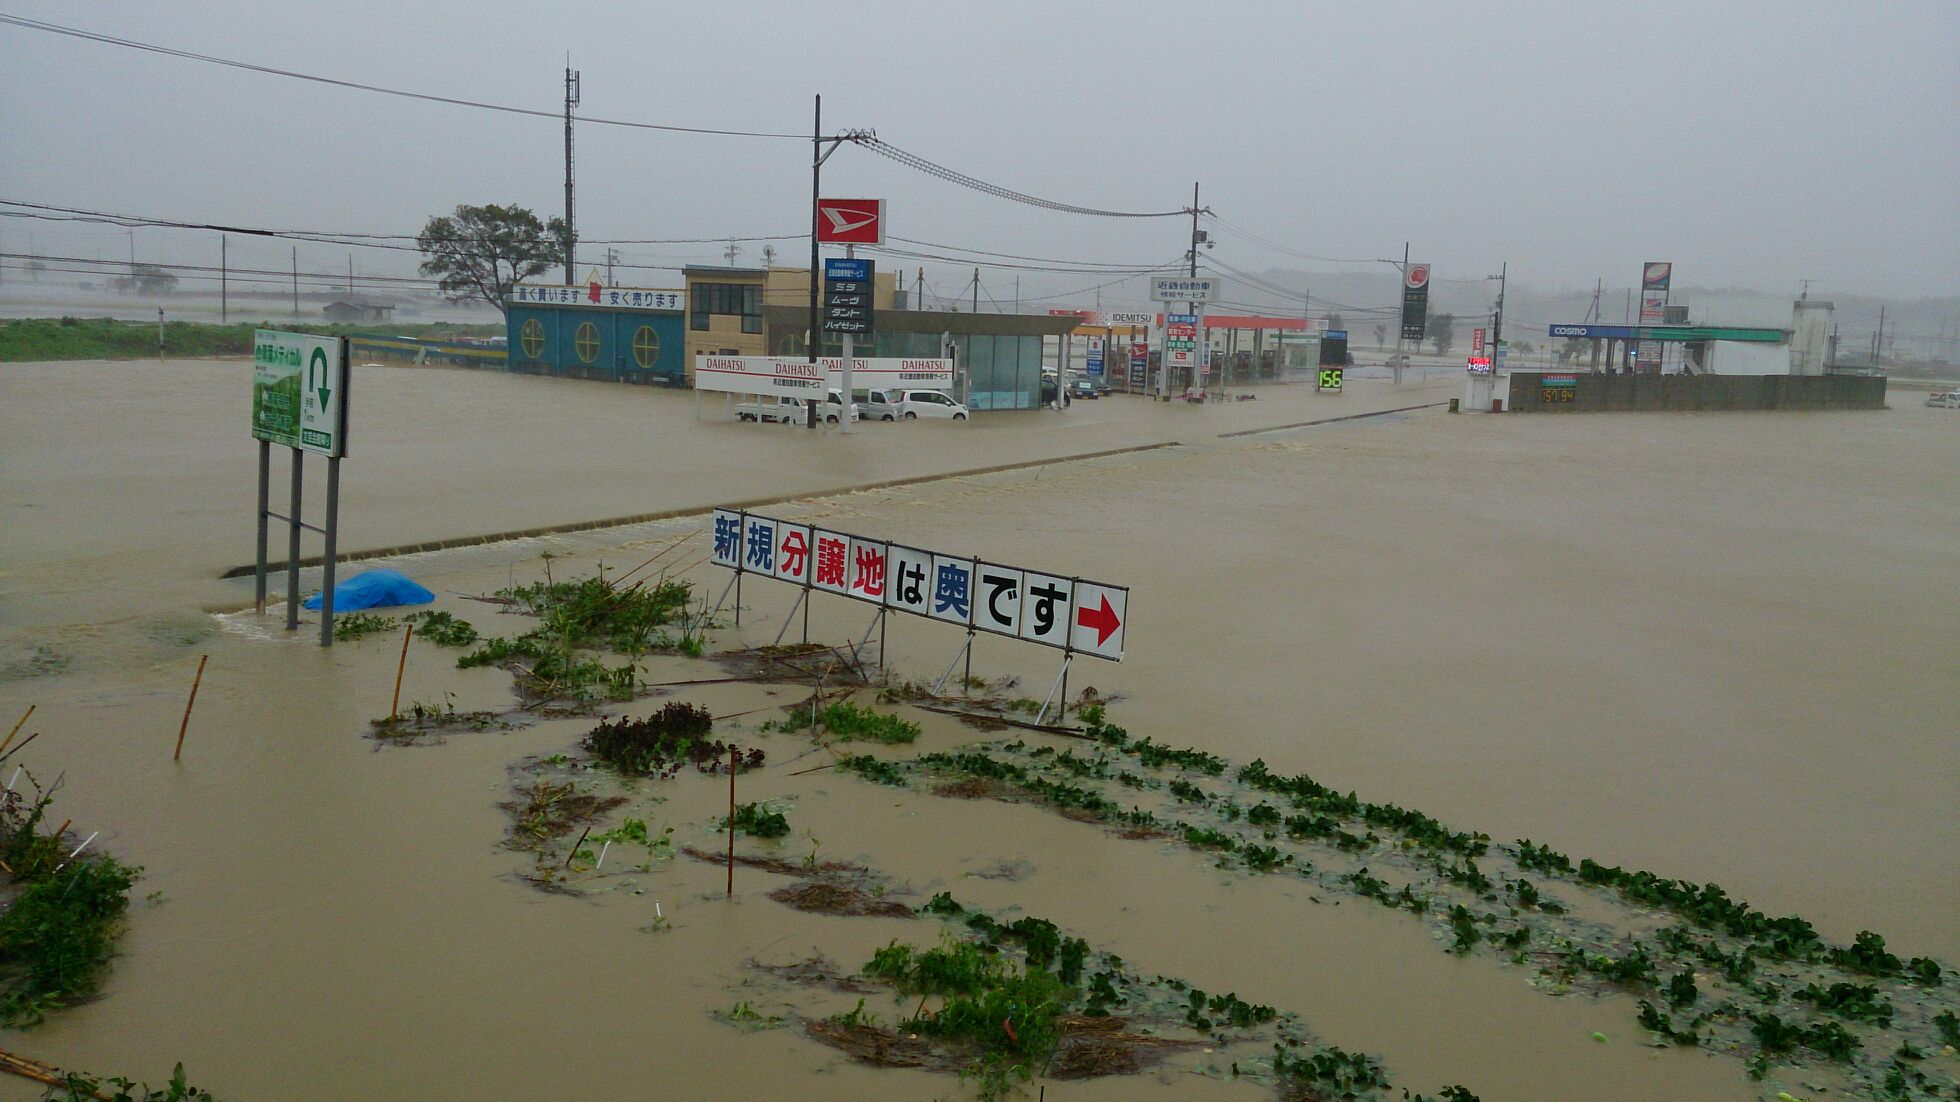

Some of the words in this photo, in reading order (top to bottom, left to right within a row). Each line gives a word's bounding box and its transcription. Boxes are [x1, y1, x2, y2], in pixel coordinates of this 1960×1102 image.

[835, 283, 856, 291] ミラ
[519, 287, 580, 303] 高く買います
[610, 291, 678, 308] 安く売ります
[831, 296, 860, 305] ムーヴ
[831, 308, 860, 317] タント
[1112, 313, 1153, 323] IDEMITSU
[825, 321, 865, 330] ハイゼット
[1554, 327, 1587, 336] COSMO
[706, 358, 746, 371] DAIHATSU
[901, 361, 945, 370] DAIHATSU
[775, 363, 818, 376] DAIHATSU
[1319, 370, 1342, 387] 156
[714, 514, 1068, 636] 新規分譲地は奥です
